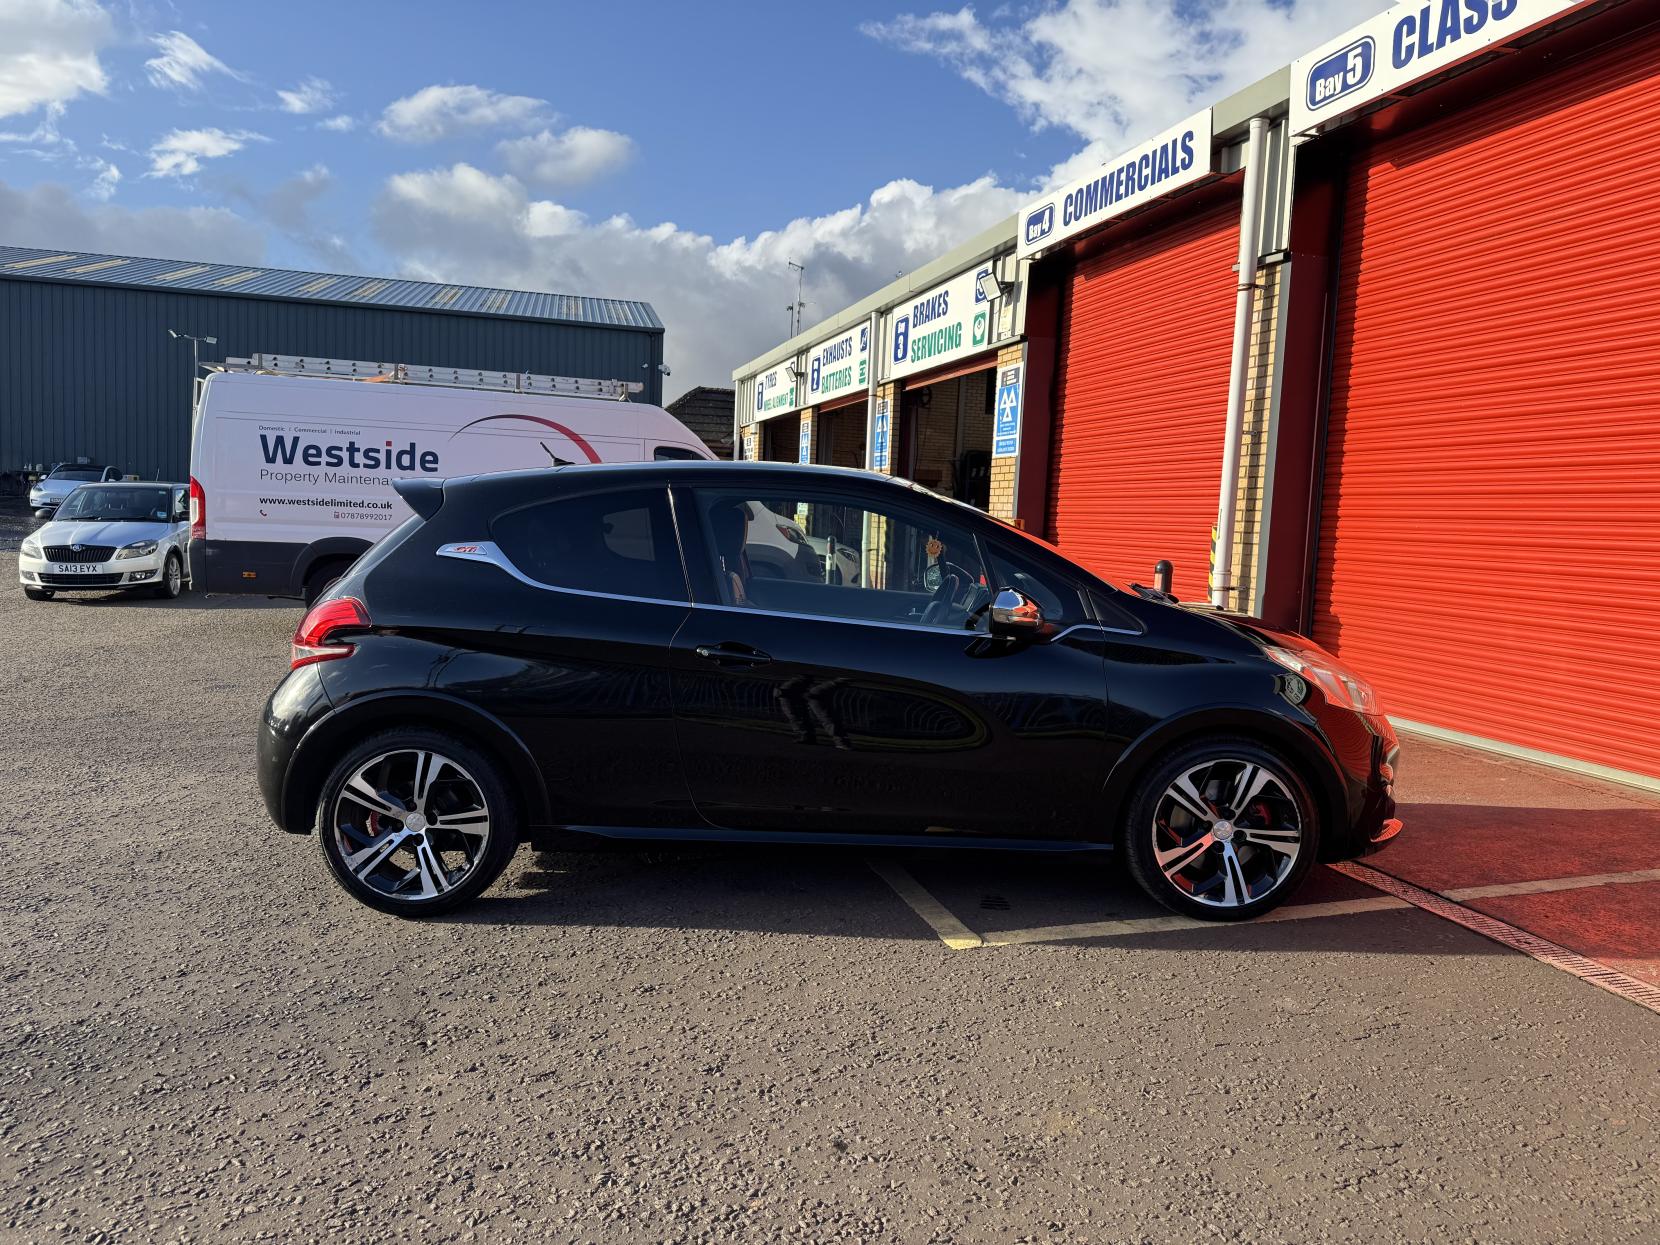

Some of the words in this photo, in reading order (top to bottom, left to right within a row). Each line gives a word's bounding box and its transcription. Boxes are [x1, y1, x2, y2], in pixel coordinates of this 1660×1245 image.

[1315, 70, 1343, 102] Bay
[1346, 46, 1363, 86] 5
[1063, 130, 1194, 227] COMMERCIALS
[1028, 222, 1042, 241] Bay
[1042, 208, 1050, 232] 4
[912, 289, 949, 329] BRAKES
[822, 335, 852, 367] EXHAUSTS
[897, 334, 904, 359] 3
[910, 321, 962, 364] SERVICING
[812, 370, 818, 390] 2
[821, 365, 852, 394] BATTERIES
[258, 424, 286, 432] Domestic
[294, 426, 327, 434] Commercial
[334, 428, 361, 436] Industrial
[259, 433, 439, 472] Westside
[260, 468, 319, 485] Property
[259, 497, 393, 510] www.westsidelimited.co.uk
[340, 511, 393, 521] 07878992017
[58, 564, 78, 573] SA13
[80, 564, 97, 573] EYX
